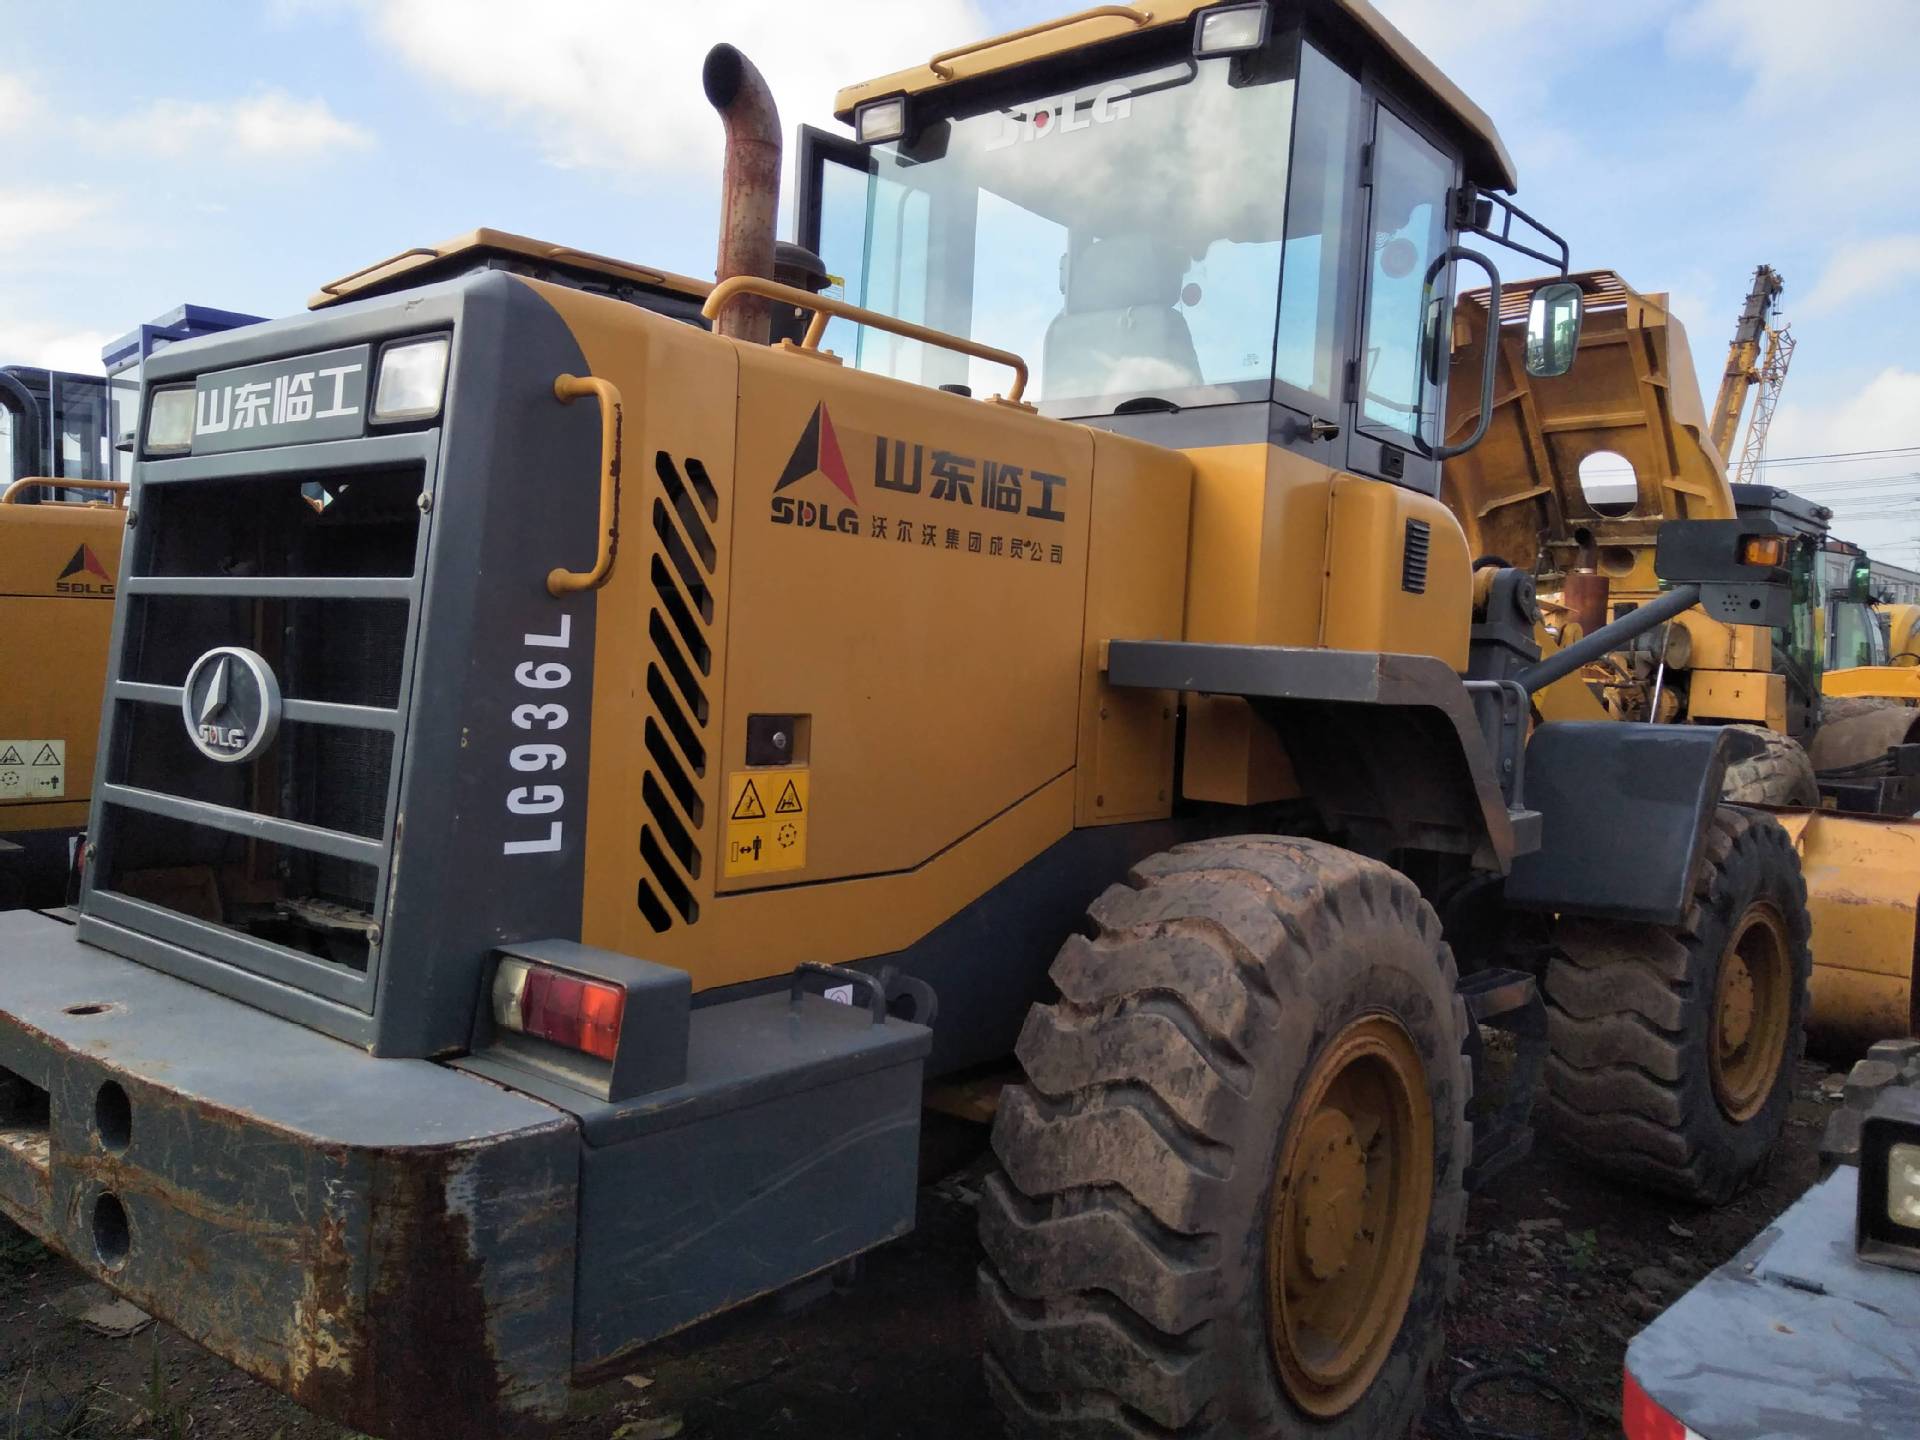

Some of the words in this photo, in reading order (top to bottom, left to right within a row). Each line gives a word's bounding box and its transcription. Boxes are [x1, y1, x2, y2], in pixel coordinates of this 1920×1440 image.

[196, 364, 362, 435] 山东临工
[874, 435, 1067, 522] 山东临工
[770, 496, 859, 535] SDLG
[871, 514, 1063, 565] 沃尔沃集团成员公司
[56, 582, 115, 595] SDLG
[199, 724, 246, 748] SDLG
[504, 614, 571, 855] LG936L
